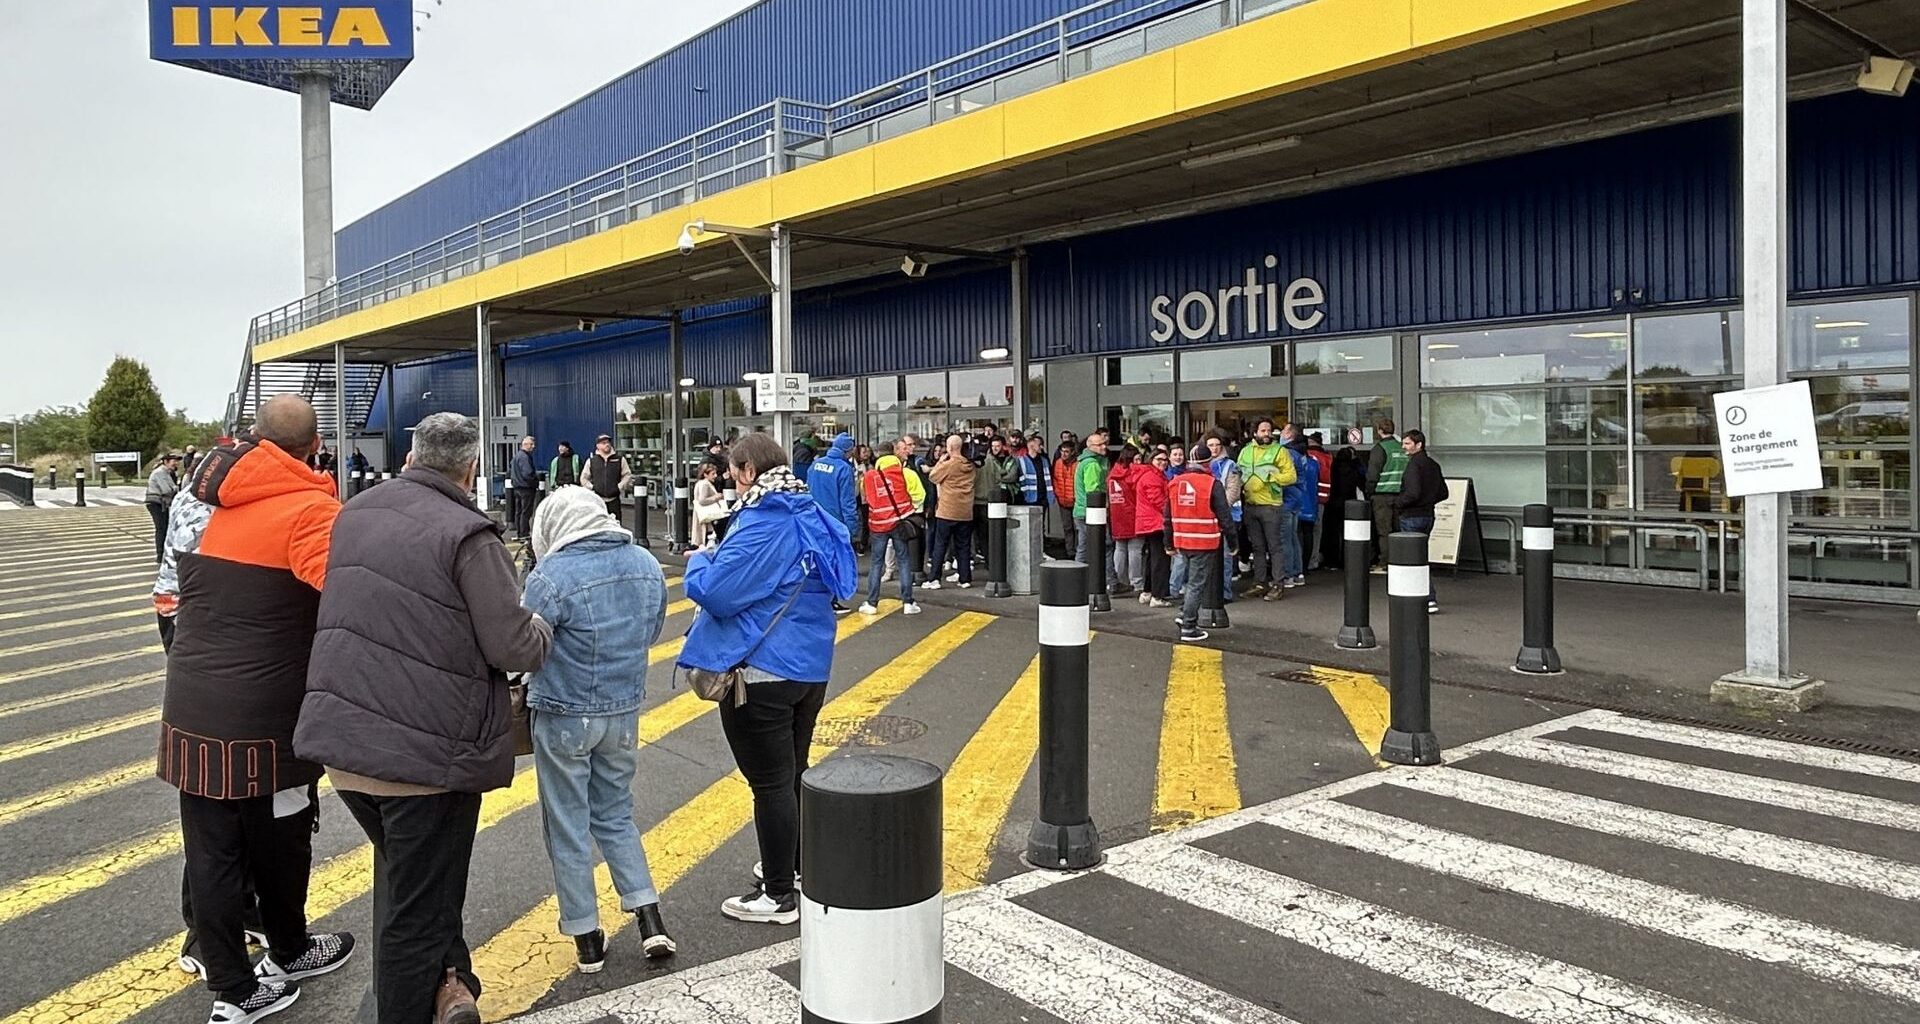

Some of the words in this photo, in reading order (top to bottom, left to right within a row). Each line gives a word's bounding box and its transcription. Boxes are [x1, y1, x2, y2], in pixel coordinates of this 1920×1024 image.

[171, 6, 391, 47] IKEA
[1150, 254, 1325, 342] sortie
[1729, 431, 1756, 442] Zone
[1758, 430, 1772, 439] de
[1731, 439, 1798, 454] chargement
